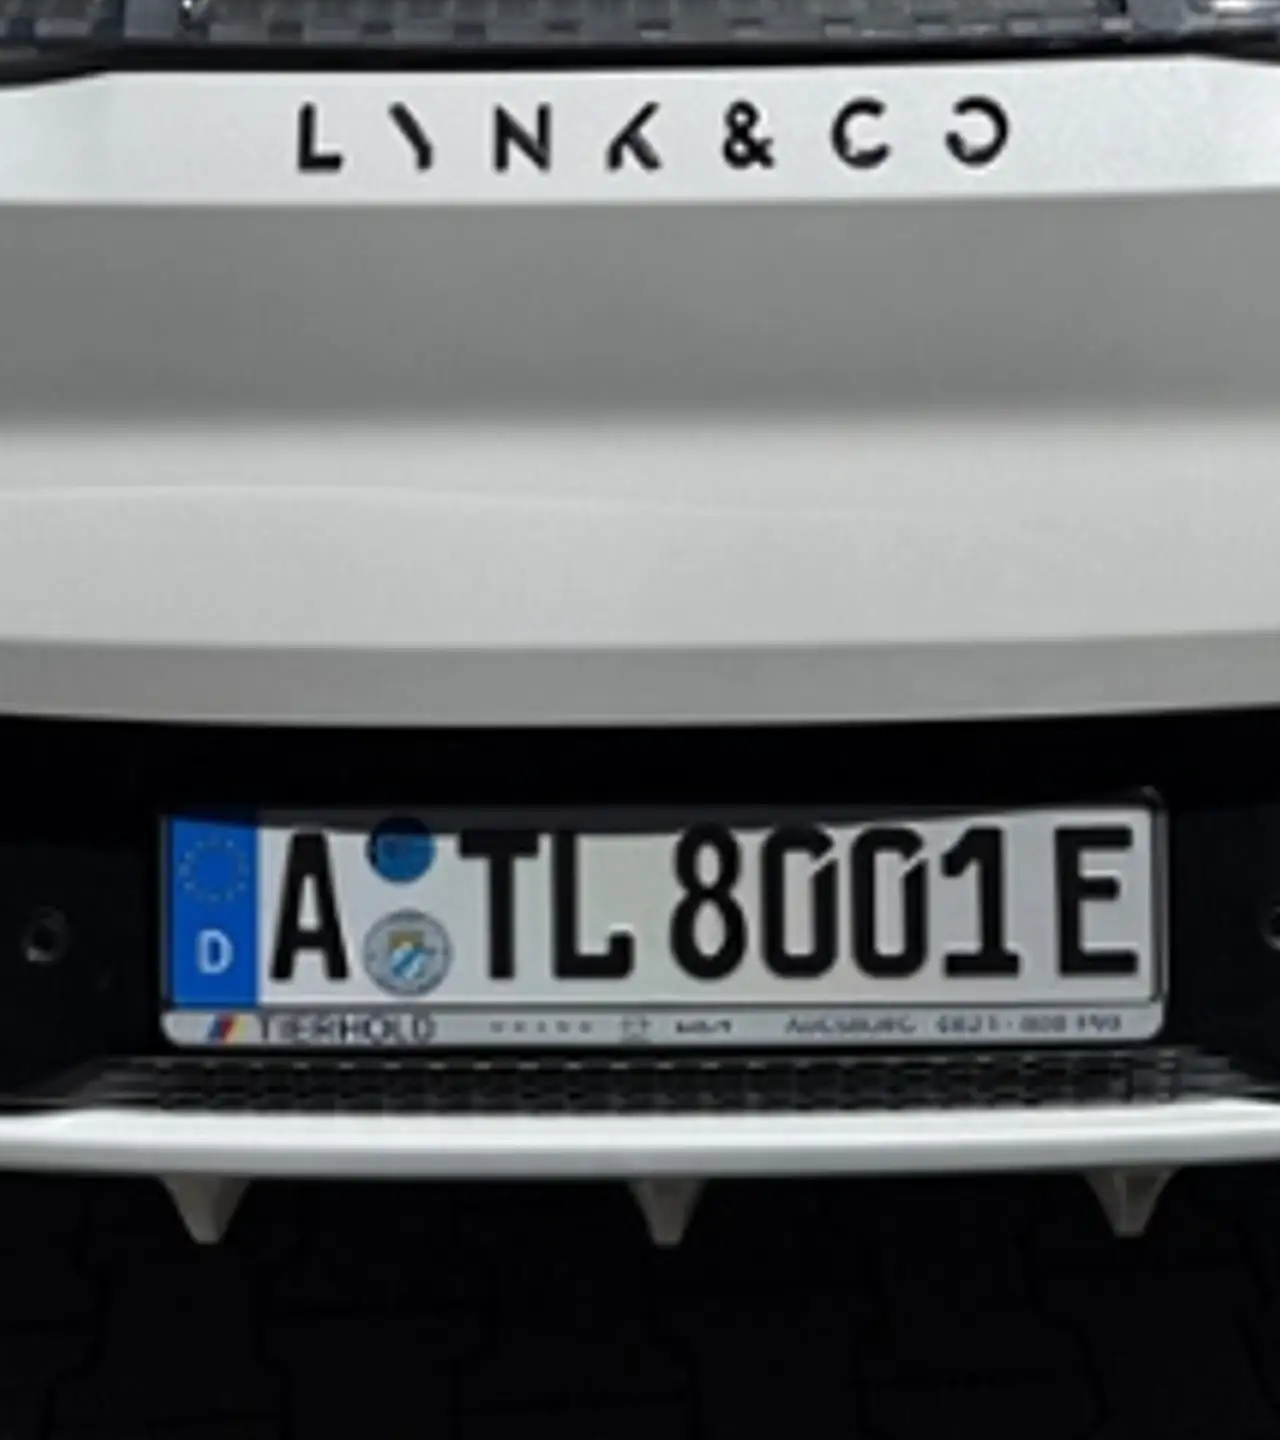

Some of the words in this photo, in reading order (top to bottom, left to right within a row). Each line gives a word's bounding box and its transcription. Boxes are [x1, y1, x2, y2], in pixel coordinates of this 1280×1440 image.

[196, 928, 234, 974] D
[269, 828, 350, 982] A
[456, 826, 636, 980] TL
